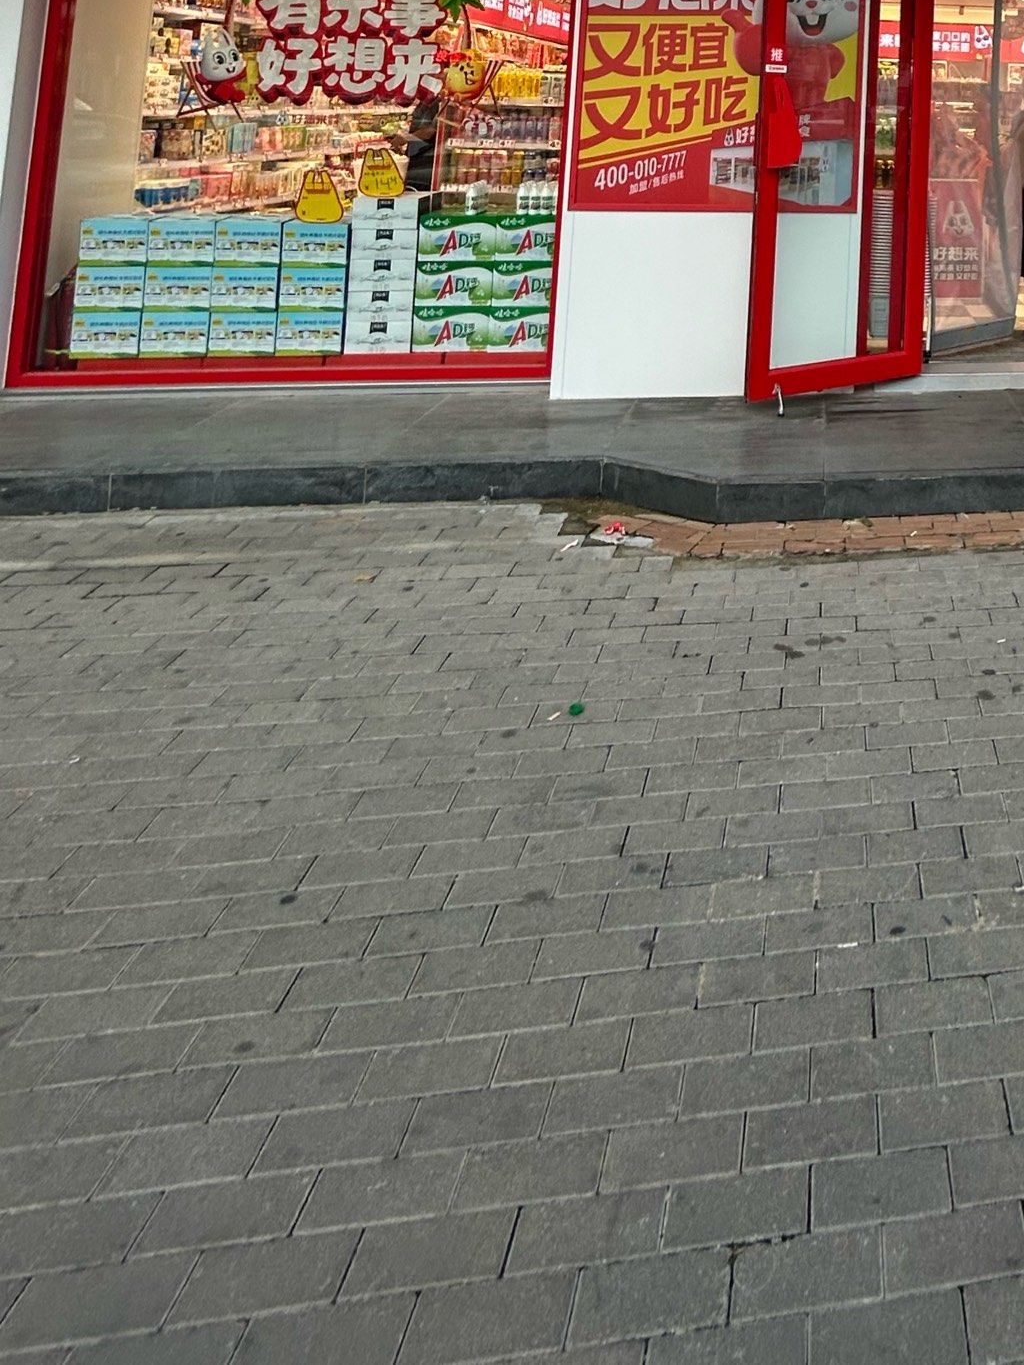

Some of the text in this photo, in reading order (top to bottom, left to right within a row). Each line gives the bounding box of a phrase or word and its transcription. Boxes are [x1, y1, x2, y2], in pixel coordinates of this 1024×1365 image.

[256, 35, 444, 97] 好想来
[584, 22, 729, 82] 又便宜
[770, 47, 784, 62] 推
[579, 75, 749, 150] 又好吃
[593, 149, 688, 191] 400-010-7777
[628, 169, 685, 196] 加盟/售后热线
[932, 246, 979, 262] 好想来
